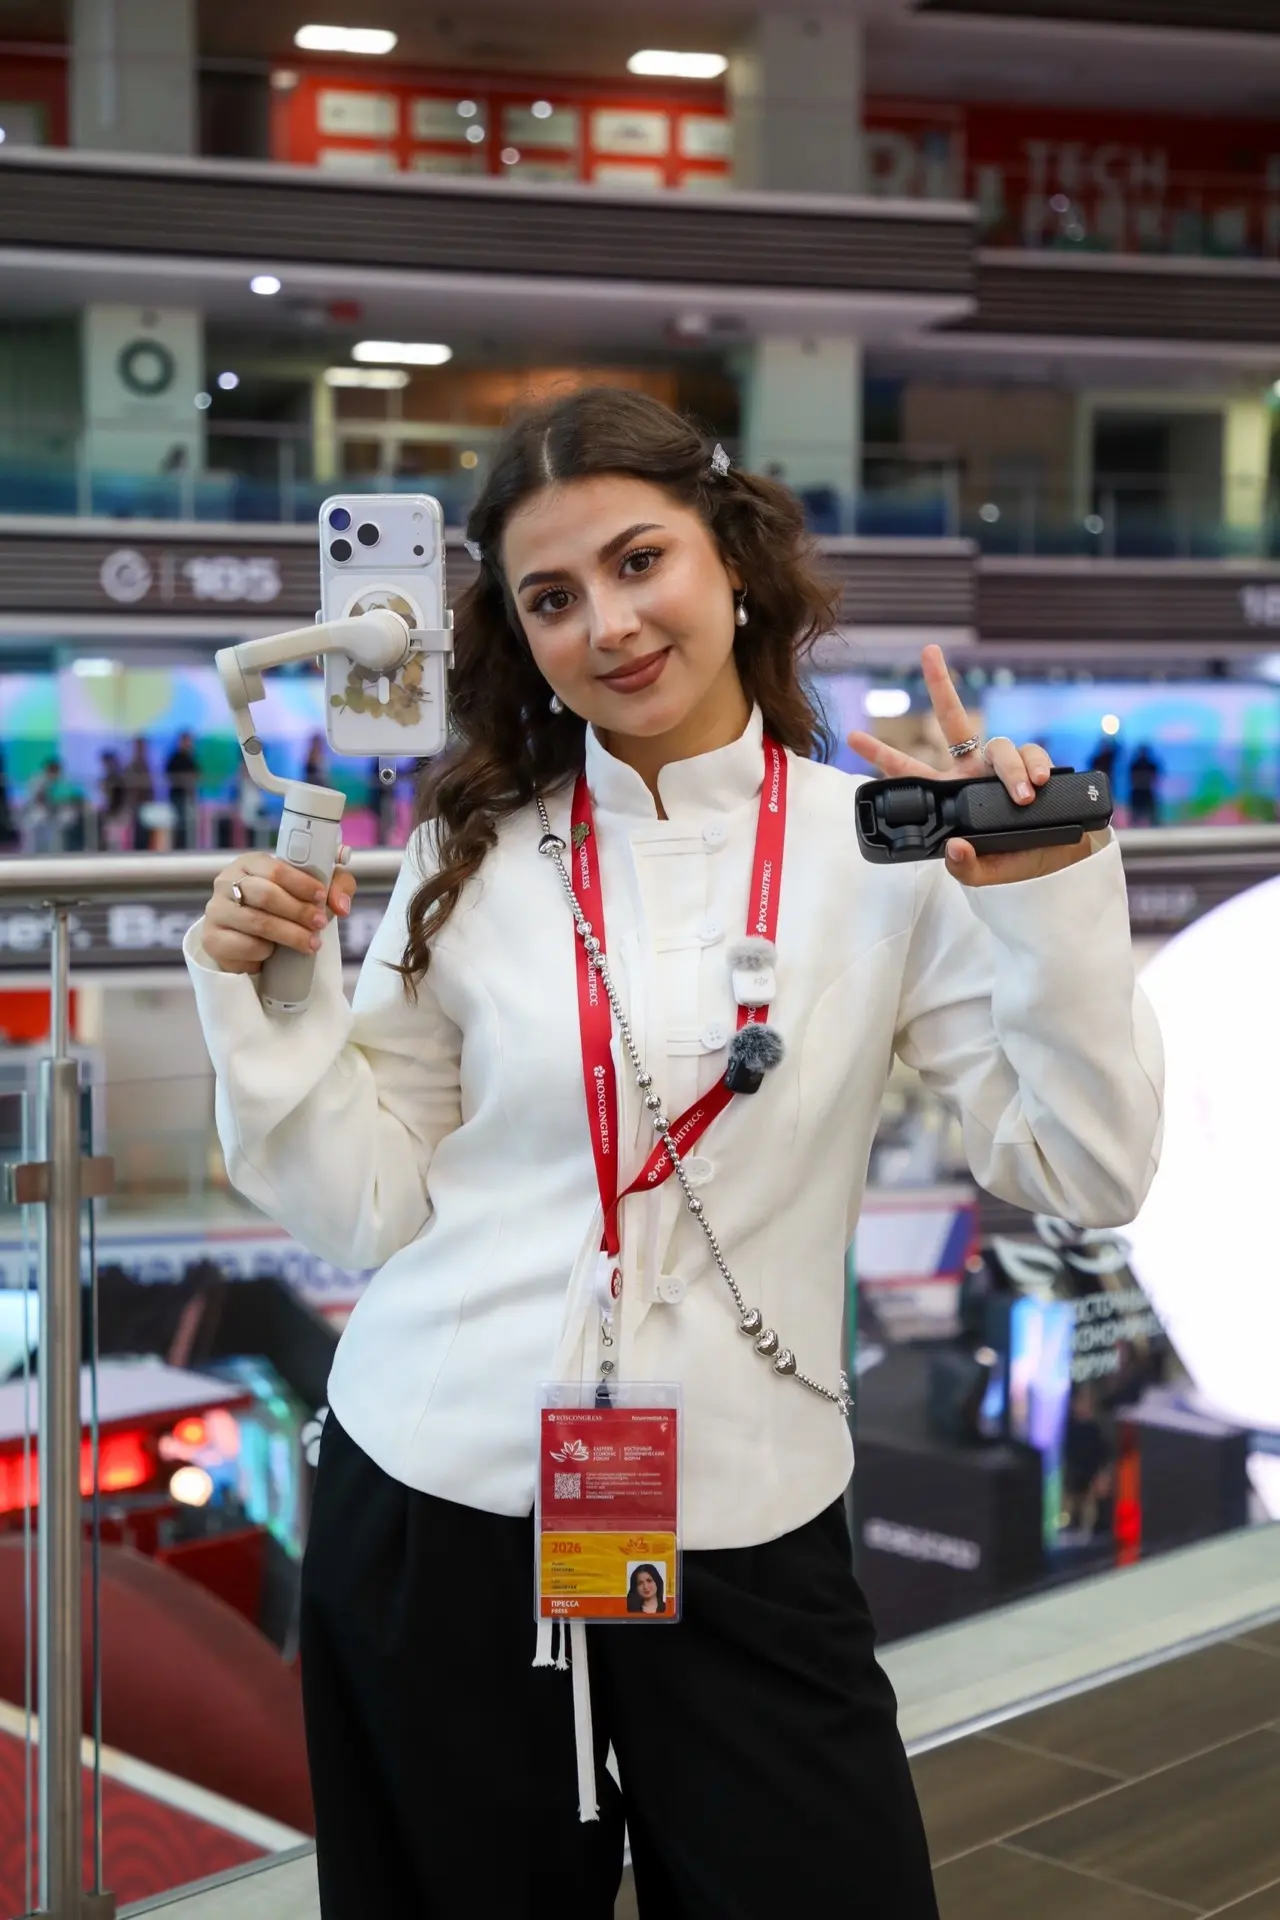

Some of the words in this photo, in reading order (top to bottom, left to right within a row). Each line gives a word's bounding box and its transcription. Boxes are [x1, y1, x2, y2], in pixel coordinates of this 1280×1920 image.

[770, 747, 780, 803] ROSCONGRESS
[579, 842, 590, 890] CONGRESS
[758, 859, 772, 923] РОСКОНГРЕСС
[595, 1078, 610, 1155] ROSCONGRESS
[654, 1109, 705, 1172] РОСОНГРЕСС
[551, 1541, 582, 1554] 2026
[551, 1600, 579, 1608] ПРЕССА
